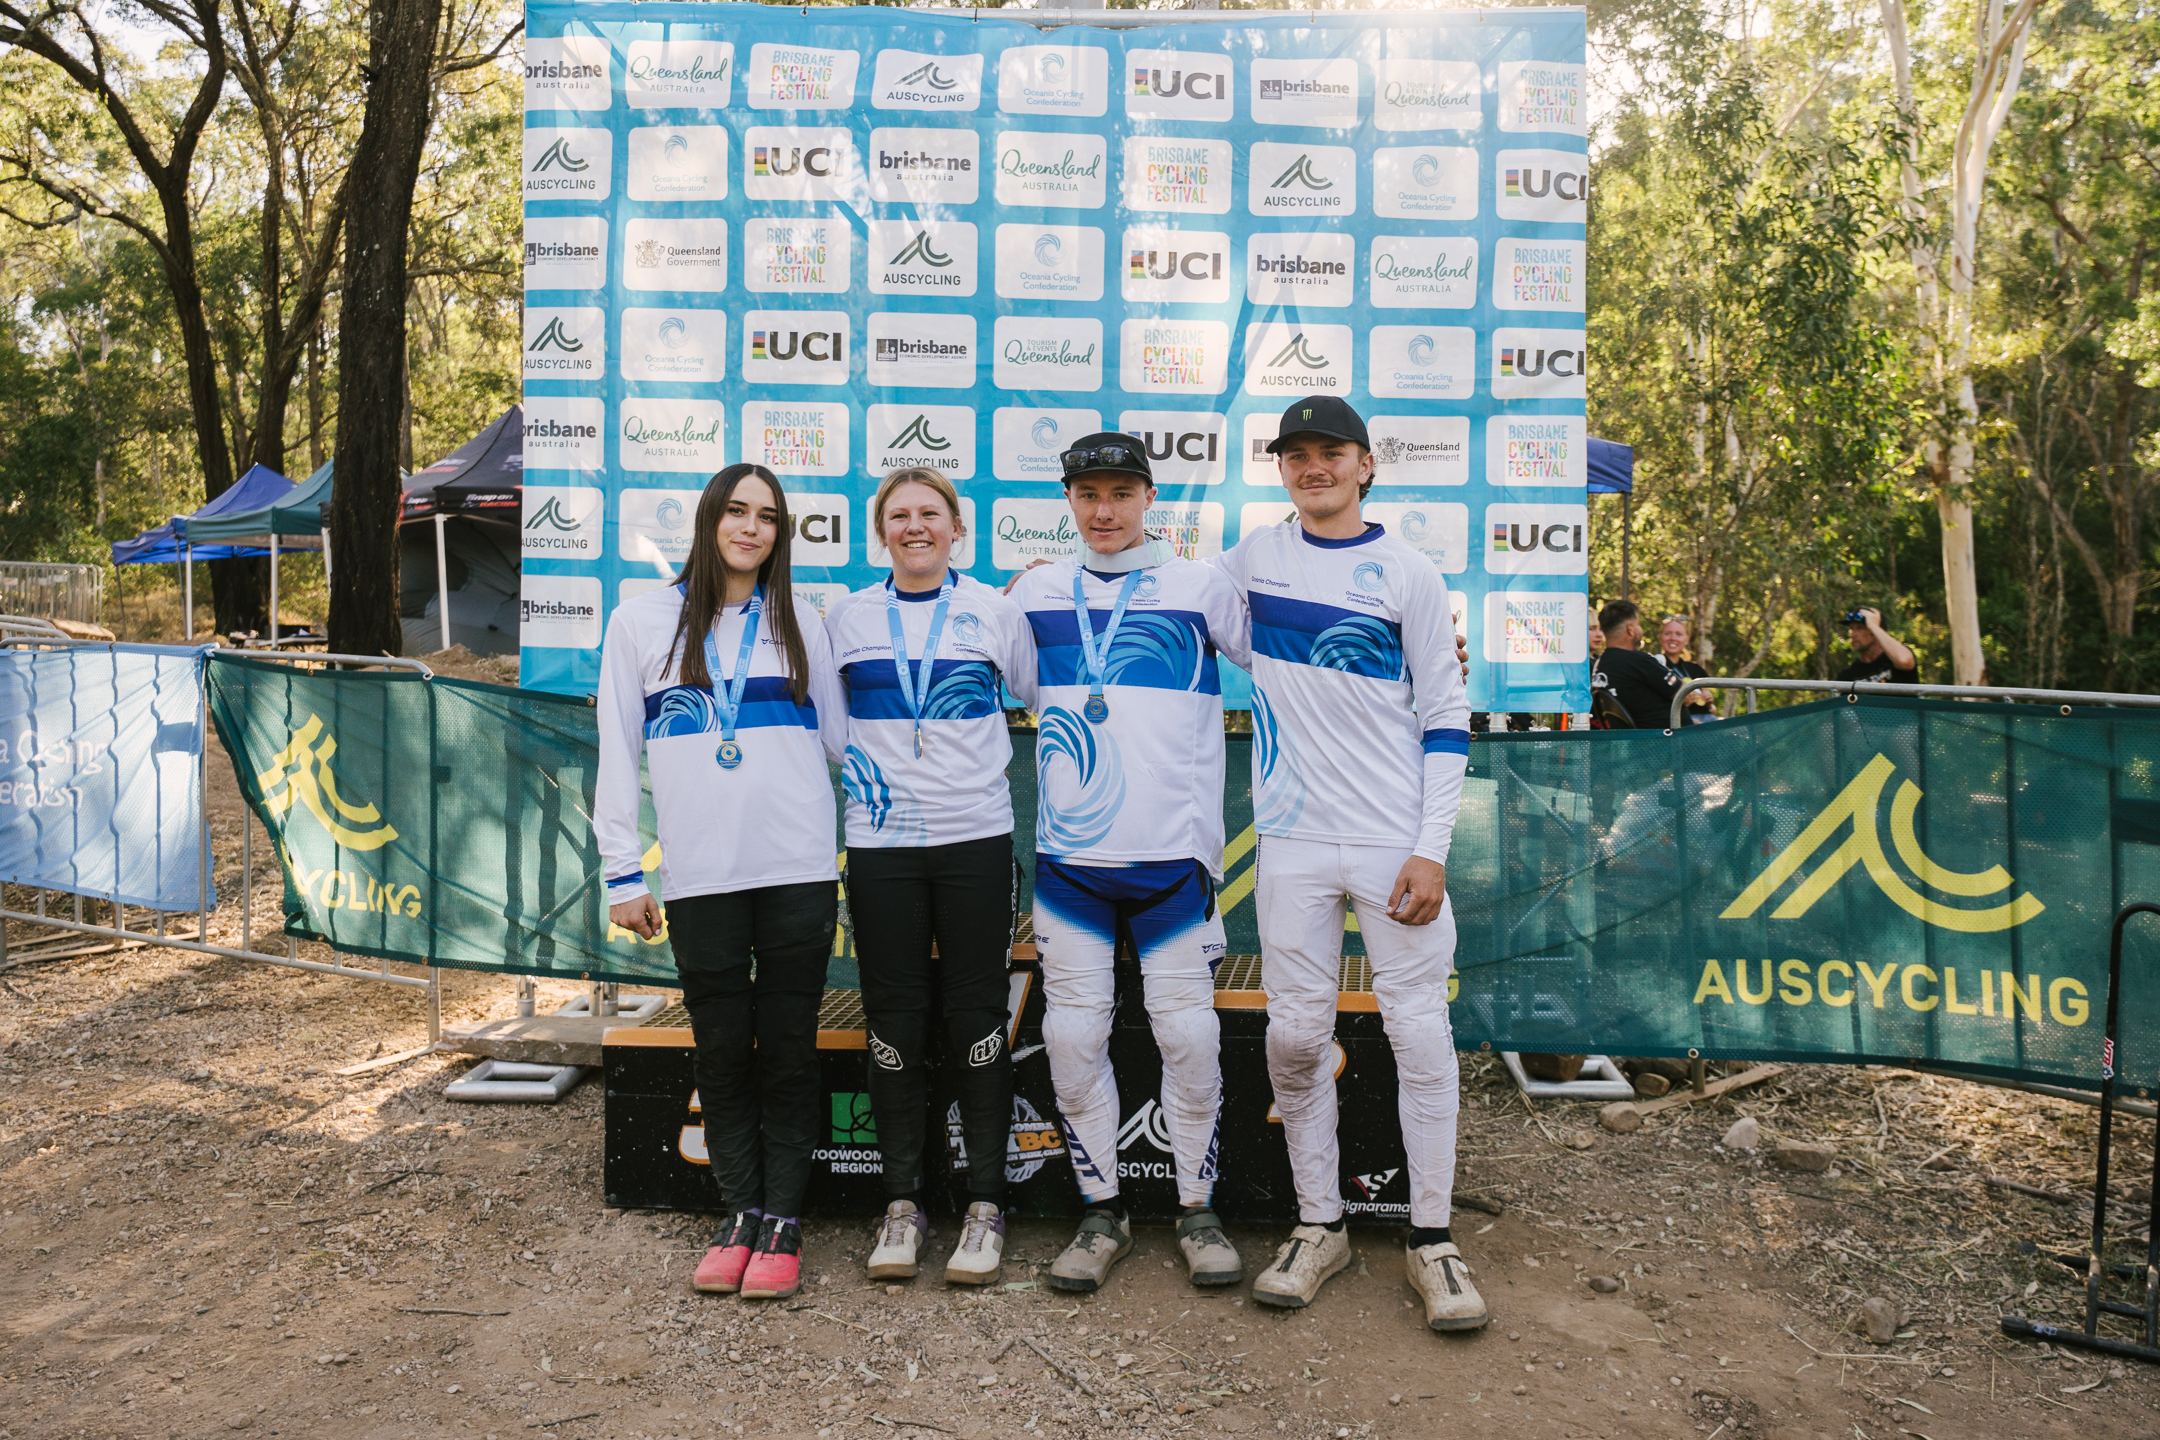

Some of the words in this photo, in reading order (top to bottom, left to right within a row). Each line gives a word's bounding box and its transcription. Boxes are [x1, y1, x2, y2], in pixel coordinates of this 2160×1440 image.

[773, 51, 835, 66] BRISBANE
[525, 60, 602, 78] brisbane
[630, 55, 728, 82] Queensland
[771, 65, 832, 82] CYCLING
[536, 81, 590, 89] australia
[1152, 70, 1225, 100] UCI
[1520, 70, 1578, 87] BRISBANE
[650, 84, 706, 94] AUSTRALIA
[770, 84, 830, 100] FESTIVAL
[1023, 88, 1054, 97] Oceania
[1056, 90, 1084, 100] Cycling
[1283, 80, 1350, 94] brisbane
[1384, 81, 1472, 108] Queensland
[886, 91, 965, 104] AUSCYCLING
[1026, 98, 1081, 108] Confederation
[1518, 88, 1578, 107] CYCLING
[1518, 107, 1576, 125] FESTIVAL
[771, 148, 844, 177] UCI
[879, 150, 972, 172] brisbane
[1148, 146, 1208, 164] BRISBANE
[1001, 149, 1100, 180] Queensland
[652, 174, 680, 183] Oceania
[682, 175, 708, 185] Cycling
[896, 173, 954, 182] australia
[1148, 164, 1208, 185] CYCLING
[526, 178, 596, 190] AUSCYCLING
[654, 184, 706, 192] Confederation
[1022, 182, 1079, 192] AUSTRALIA
[1523, 169, 1586, 200] UCI
[1148, 185, 1208, 204] FESTIVAL
[1263, 196, 1341, 207] AUSCYCLING
[1398, 191, 1428, 202] Oceania
[1429, 193, 1456, 204] Cycling
[1400, 202, 1454, 212] Confederation
[767, 228, 826, 244] BRISBANE
[537, 242, 599, 257] brisbane
[667, 246, 721, 257] Queensland
[767, 246, 826, 264] CYCLING
[1514, 248, 1572, 264] BRISBANE
[666, 258, 720, 267] Government
[1148, 252, 1222, 280] UCI
[1256, 254, 1346, 276] brisbane
[1375, 252, 1473, 282] Queensland
[767, 266, 826, 284] FESTIVAL
[883, 273, 961, 286] AUSCYCLING
[1019, 272, 1051, 282] Oceania
[1052, 273, 1081, 284] Cycling
[1273, 276, 1328, 286] australia
[1514, 265, 1572, 284] CYCLING
[1023, 281, 1078, 291] Confederation
[1396, 284, 1452, 293] AUSTRALIA
[1514, 285, 1572, 302] FESTIVAL
[1144, 329, 1204, 346] BRISBANE
[769, 332, 842, 362] UCI
[900, 339, 967, 354] brisbane
[1004, 339, 1095, 366] Queensland
[524, 358, 592, 370] AUSCYCLING
[645, 354, 674, 364] Oceania
[676, 355, 704, 366] Cycling
[1144, 346, 1204, 366] CYCLING
[1517, 348, 1584, 377] UCI
[648, 364, 702, 374] Confederation
[1143, 366, 1204, 384] FESTIVAL
[1260, 374, 1337, 387] AUSCYCLING
[1393, 372, 1424, 382] Oceania
[1426, 372, 1453, 384] Cycling
[1396, 381, 1450, 391] Confederation
[764, 411, 825, 428] BRISBANE
[624, 416, 720, 444] Queensland
[764, 428, 825, 448] CYCLING
[1508, 425, 1568, 441] BRISBANE
[528, 440, 580, 448] australia
[1144, 432, 1217, 462] UCI
[1407, 442, 1460, 452] Queensland
[1508, 442, 1568, 460] CYCLING
[644, 448, 699, 458] AUSTRALIA
[764, 450, 824, 467] FESTIVAL
[1017, 454, 1048, 463] Oceania
[1406, 452, 1460, 462] Government
[881, 457, 959, 470] AUSCYCLING
[1020, 464, 1064, 472] Confederat
[1508, 461, 1568, 478] FESTIVAL
[998, 515, 1078, 544] Queenslan
[674, 536, 692, 545] Cycl
[1511, 524, 1582, 553] UCI
[1018, 547, 1074, 556] AUSTRALIA
[530, 600, 594, 615] brisbane
[1506, 602, 1565, 617] BRISBANE
[1506, 618, 1565, 638] CYCLING
[1506, 638, 1565, 654] FESTIVAL
[0, 778, 83, 808] eration
[1693, 959, 2090, 1026] AUSCYCLING
[812, 1149, 882, 1161] TOOWOOM
[831, 1162, 883, 1174] REGION
[1118, 1162, 1175, 1178] SCYCL
